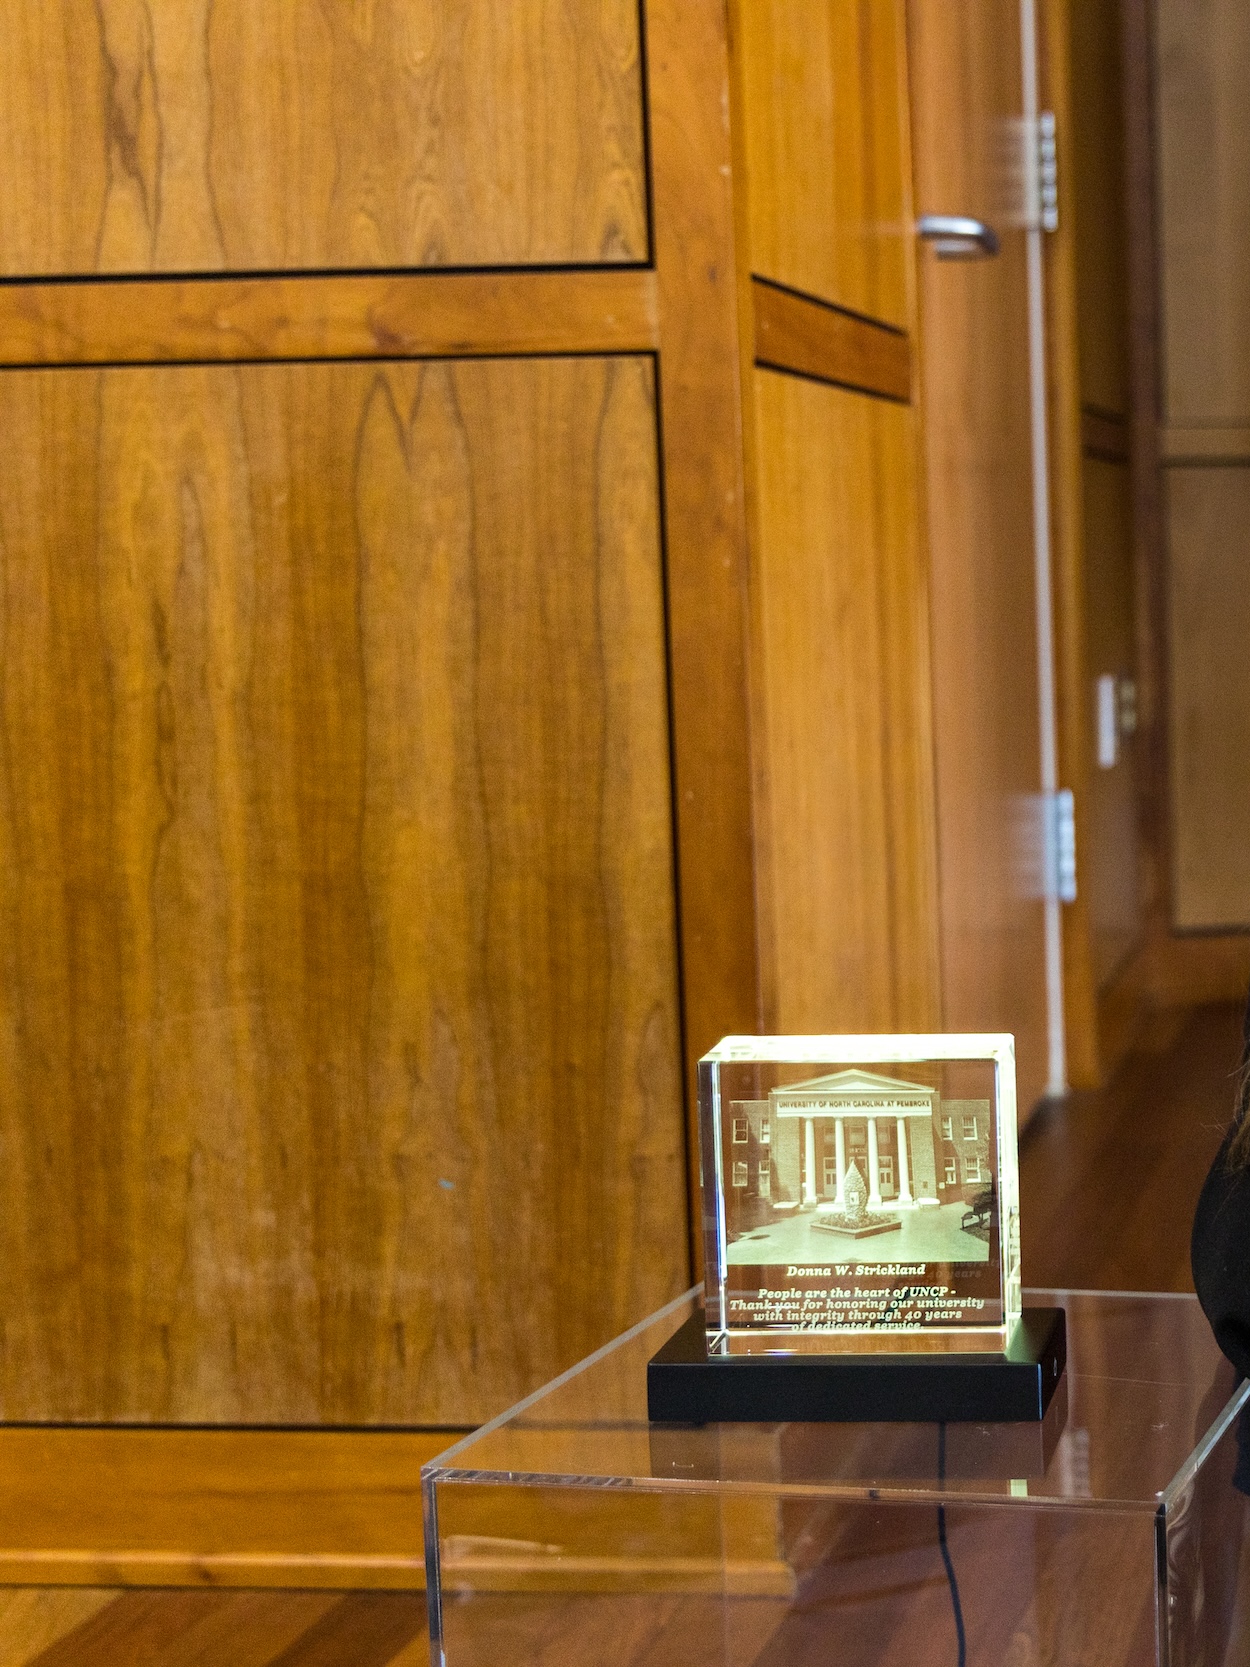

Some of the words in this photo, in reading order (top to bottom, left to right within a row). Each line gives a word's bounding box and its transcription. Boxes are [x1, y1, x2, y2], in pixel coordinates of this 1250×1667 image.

[886, 1100, 895, 1108] AT
[786, 1265, 832, 1277] Donna
[834, 1265, 853, 1276] W.
[855, 1264, 926, 1276] Strickland
[757, 1288, 802, 1300] People
[804, 1290, 827, 1298] are
[830, 1287, 851, 1298] the
[854, 1287, 890, 1297] heart
[893, 1286, 909, 1299] of
[909, 1286, 949, 1297] UNCP
[730, 1299, 772, 1310] Thank
[775, 1301, 800, 1312] you
[801, 1299, 823, 1311] for
[826, 1298, 887, 1310] honoring
[890, 1299, 914, 1308] our
[917, 1297, 985, 1309] university
[753, 1310, 783, 1321] with
[786, 1310, 845, 1323] integrity
[848, 1310, 902, 1321] through
[905, 1311, 922, 1319] 40
[925, 1311, 963, 1321] years
[791, 1321, 806, 1331] of
[807, 1320, 872, 1331] dedicated
[873, 1321, 924, 1330] service.
